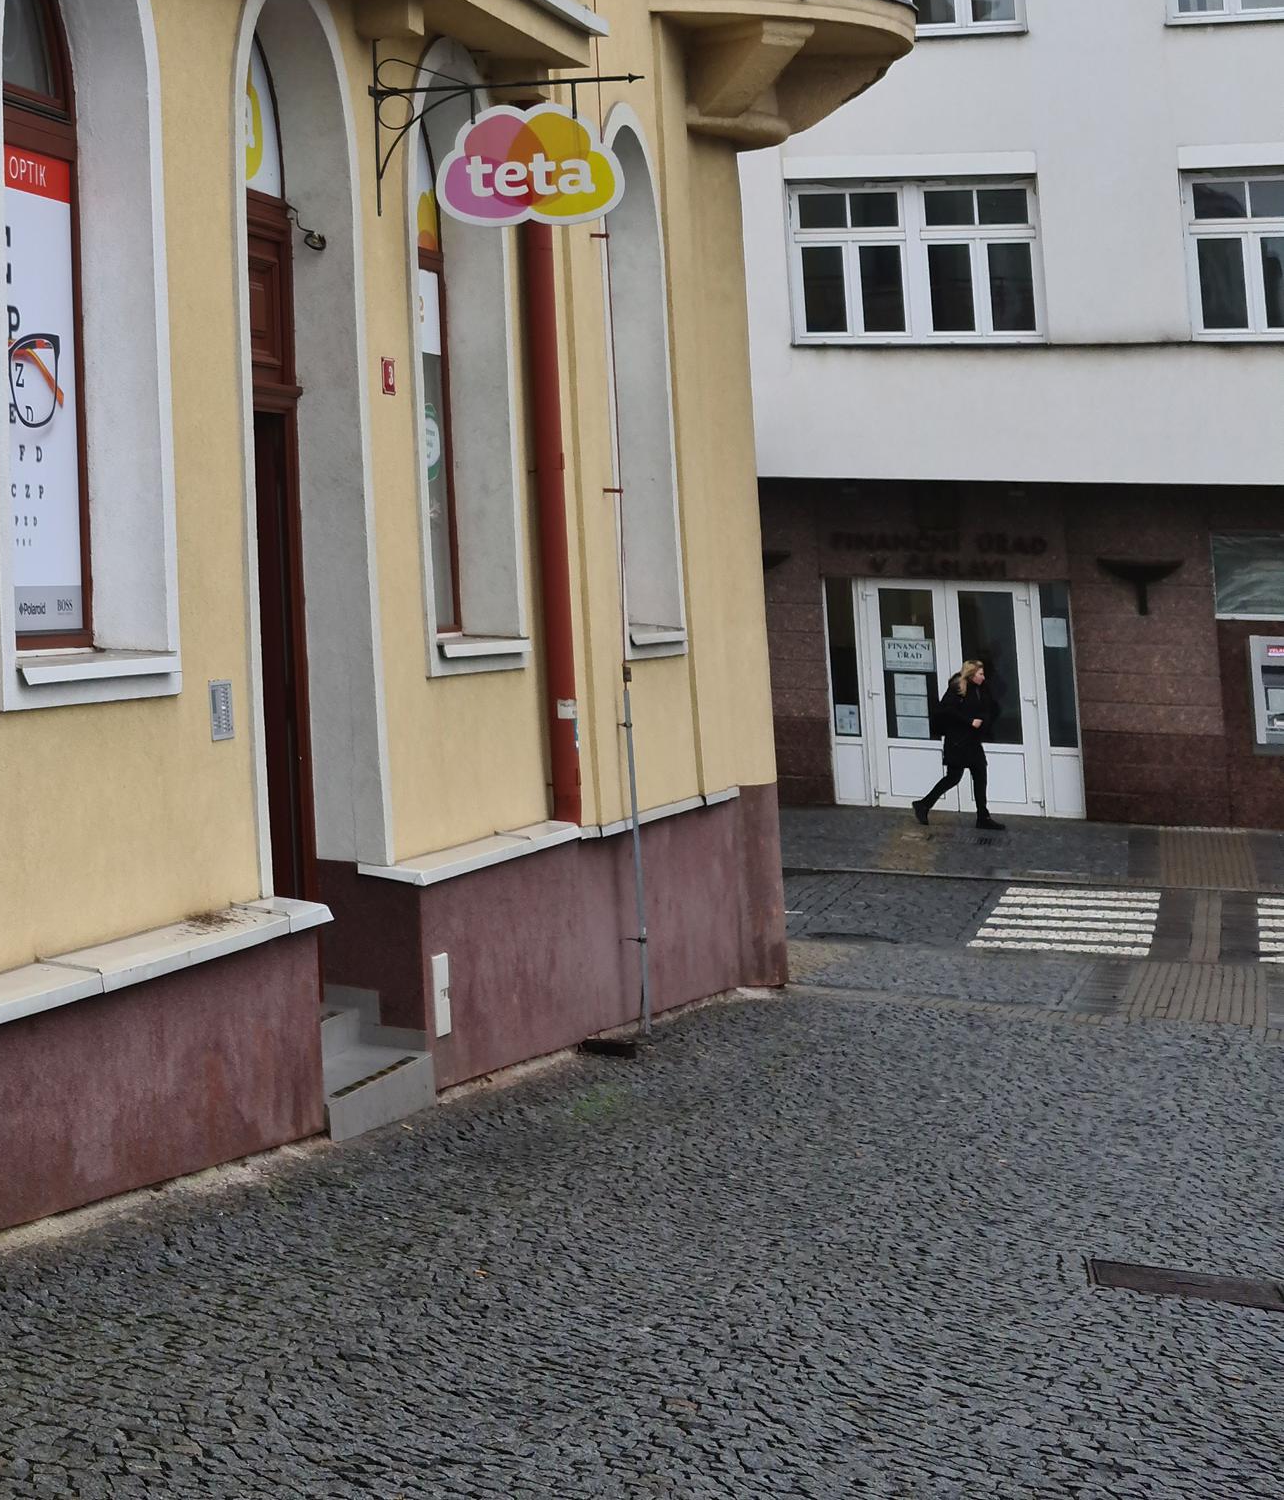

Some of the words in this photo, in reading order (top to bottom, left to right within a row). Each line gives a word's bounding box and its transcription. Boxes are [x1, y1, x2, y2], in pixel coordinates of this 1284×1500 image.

[9, 155, 46, 187] OPTIK
[466, 153, 596, 197] teta
[15, 363, 25, 388] Z
[36, 446, 43, 463] D
[24, 602, 46, 616] Polaroid
[57, 599, 73, 612] BOSS
